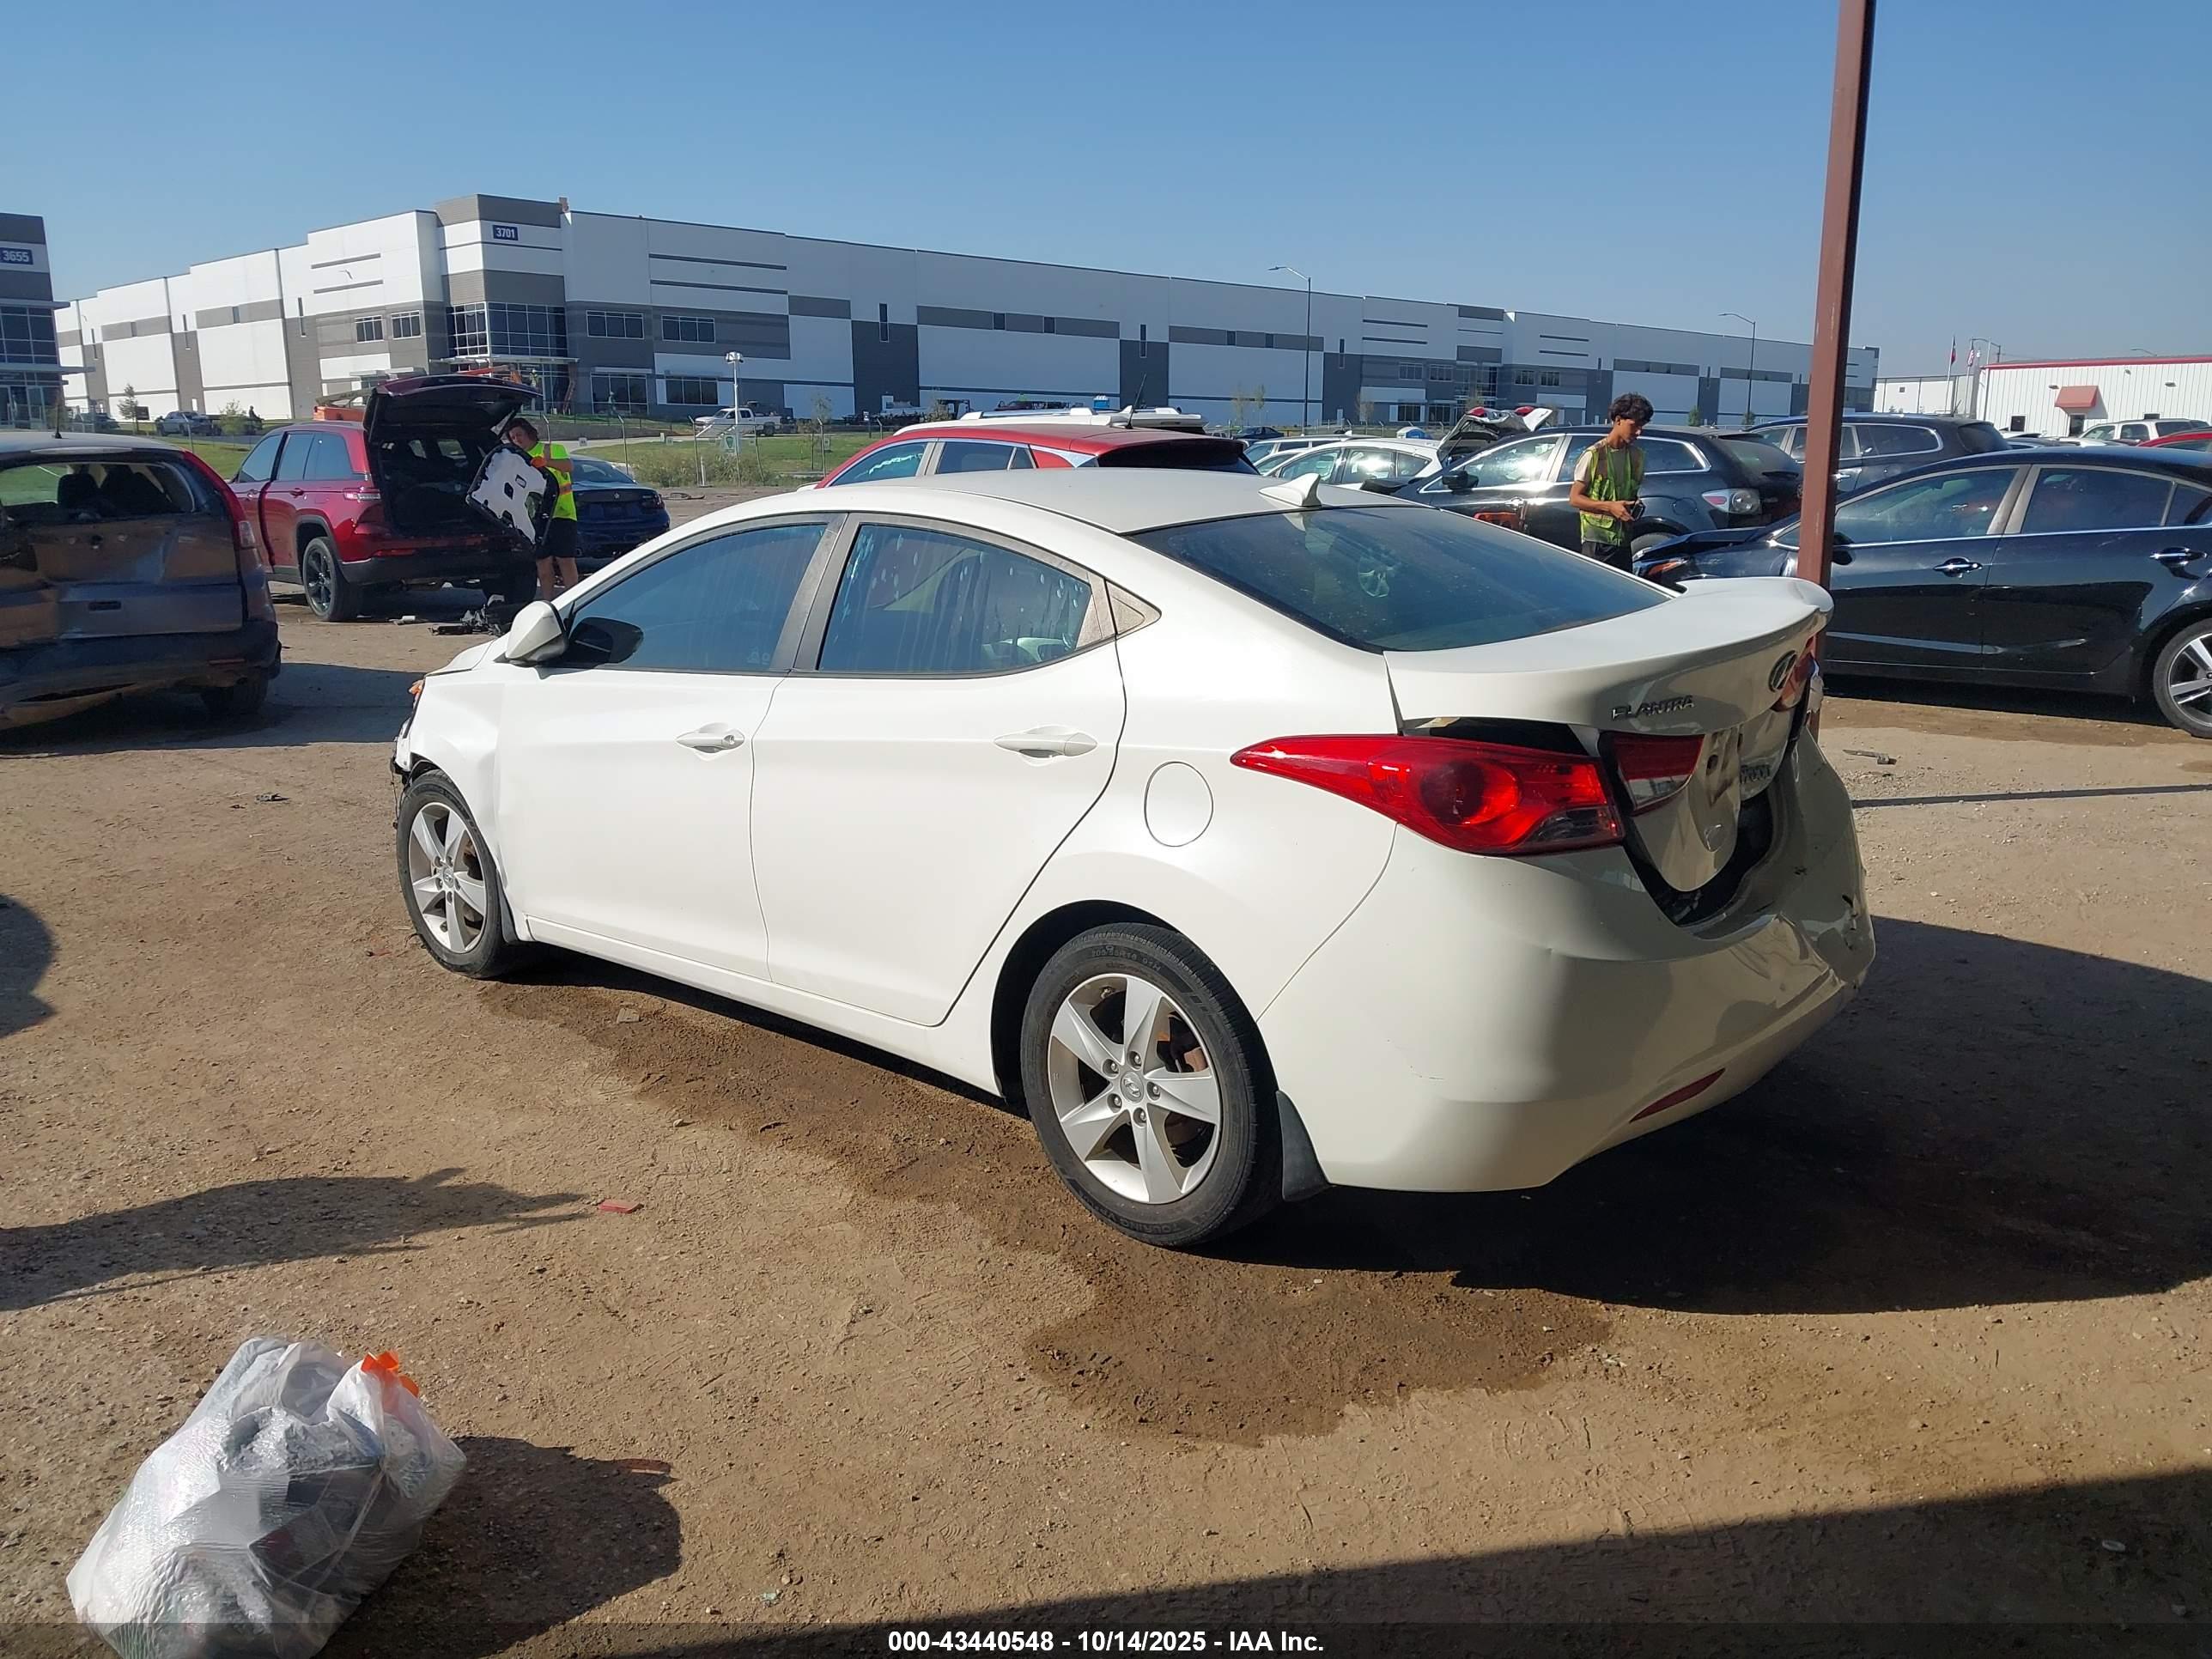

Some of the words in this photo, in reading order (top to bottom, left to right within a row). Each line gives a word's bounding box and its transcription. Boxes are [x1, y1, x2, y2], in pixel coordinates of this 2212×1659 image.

[495, 227, 515, 239] 3701
[2, 250, 29, 262] 3655
[1611, 695, 1695, 721] ELANTRA
